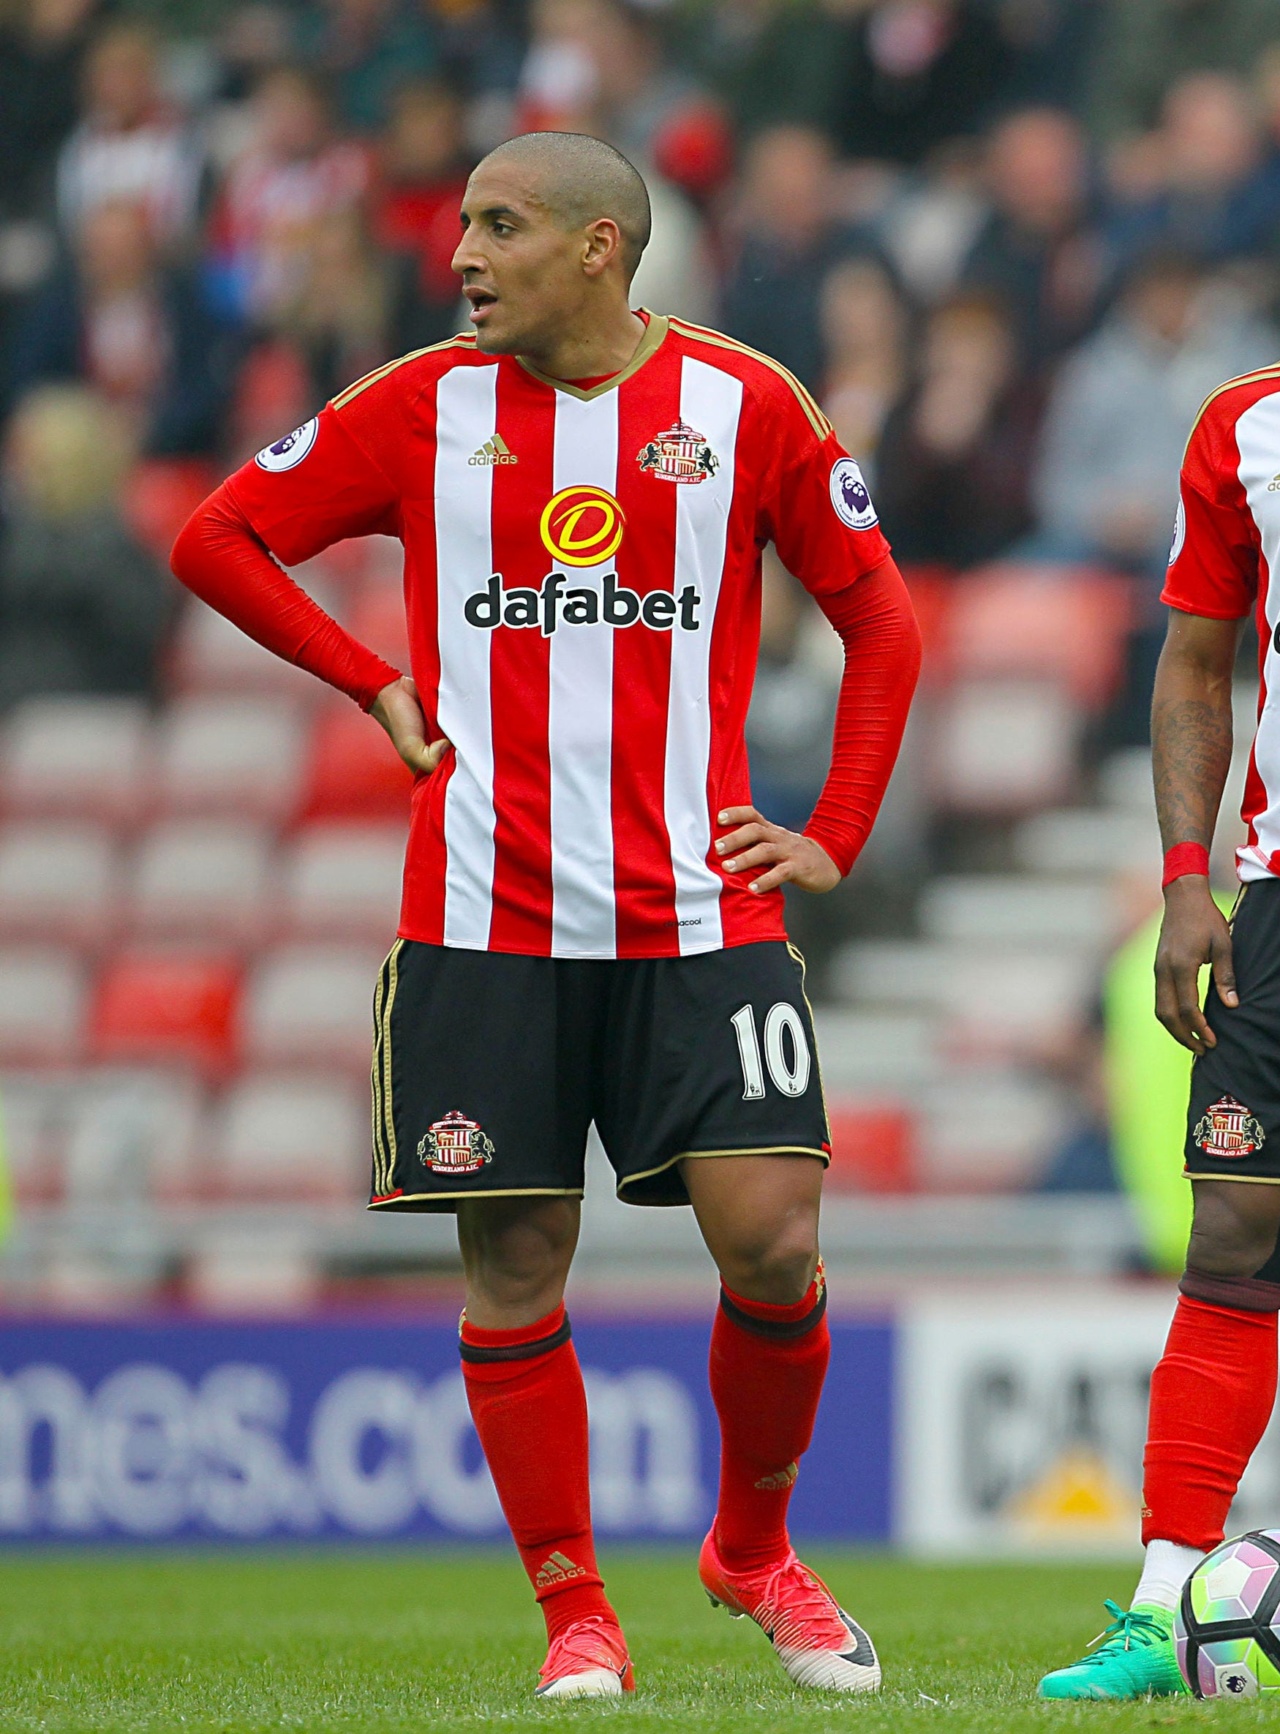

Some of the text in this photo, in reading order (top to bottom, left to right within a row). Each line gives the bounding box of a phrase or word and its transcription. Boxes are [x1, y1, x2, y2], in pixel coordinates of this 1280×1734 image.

[468, 453, 518, 466] adidas
[463, 573, 701, 636] dafabet
[730, 1002, 811, 1100] 10
[536, 1566, 586, 1587] adidas
